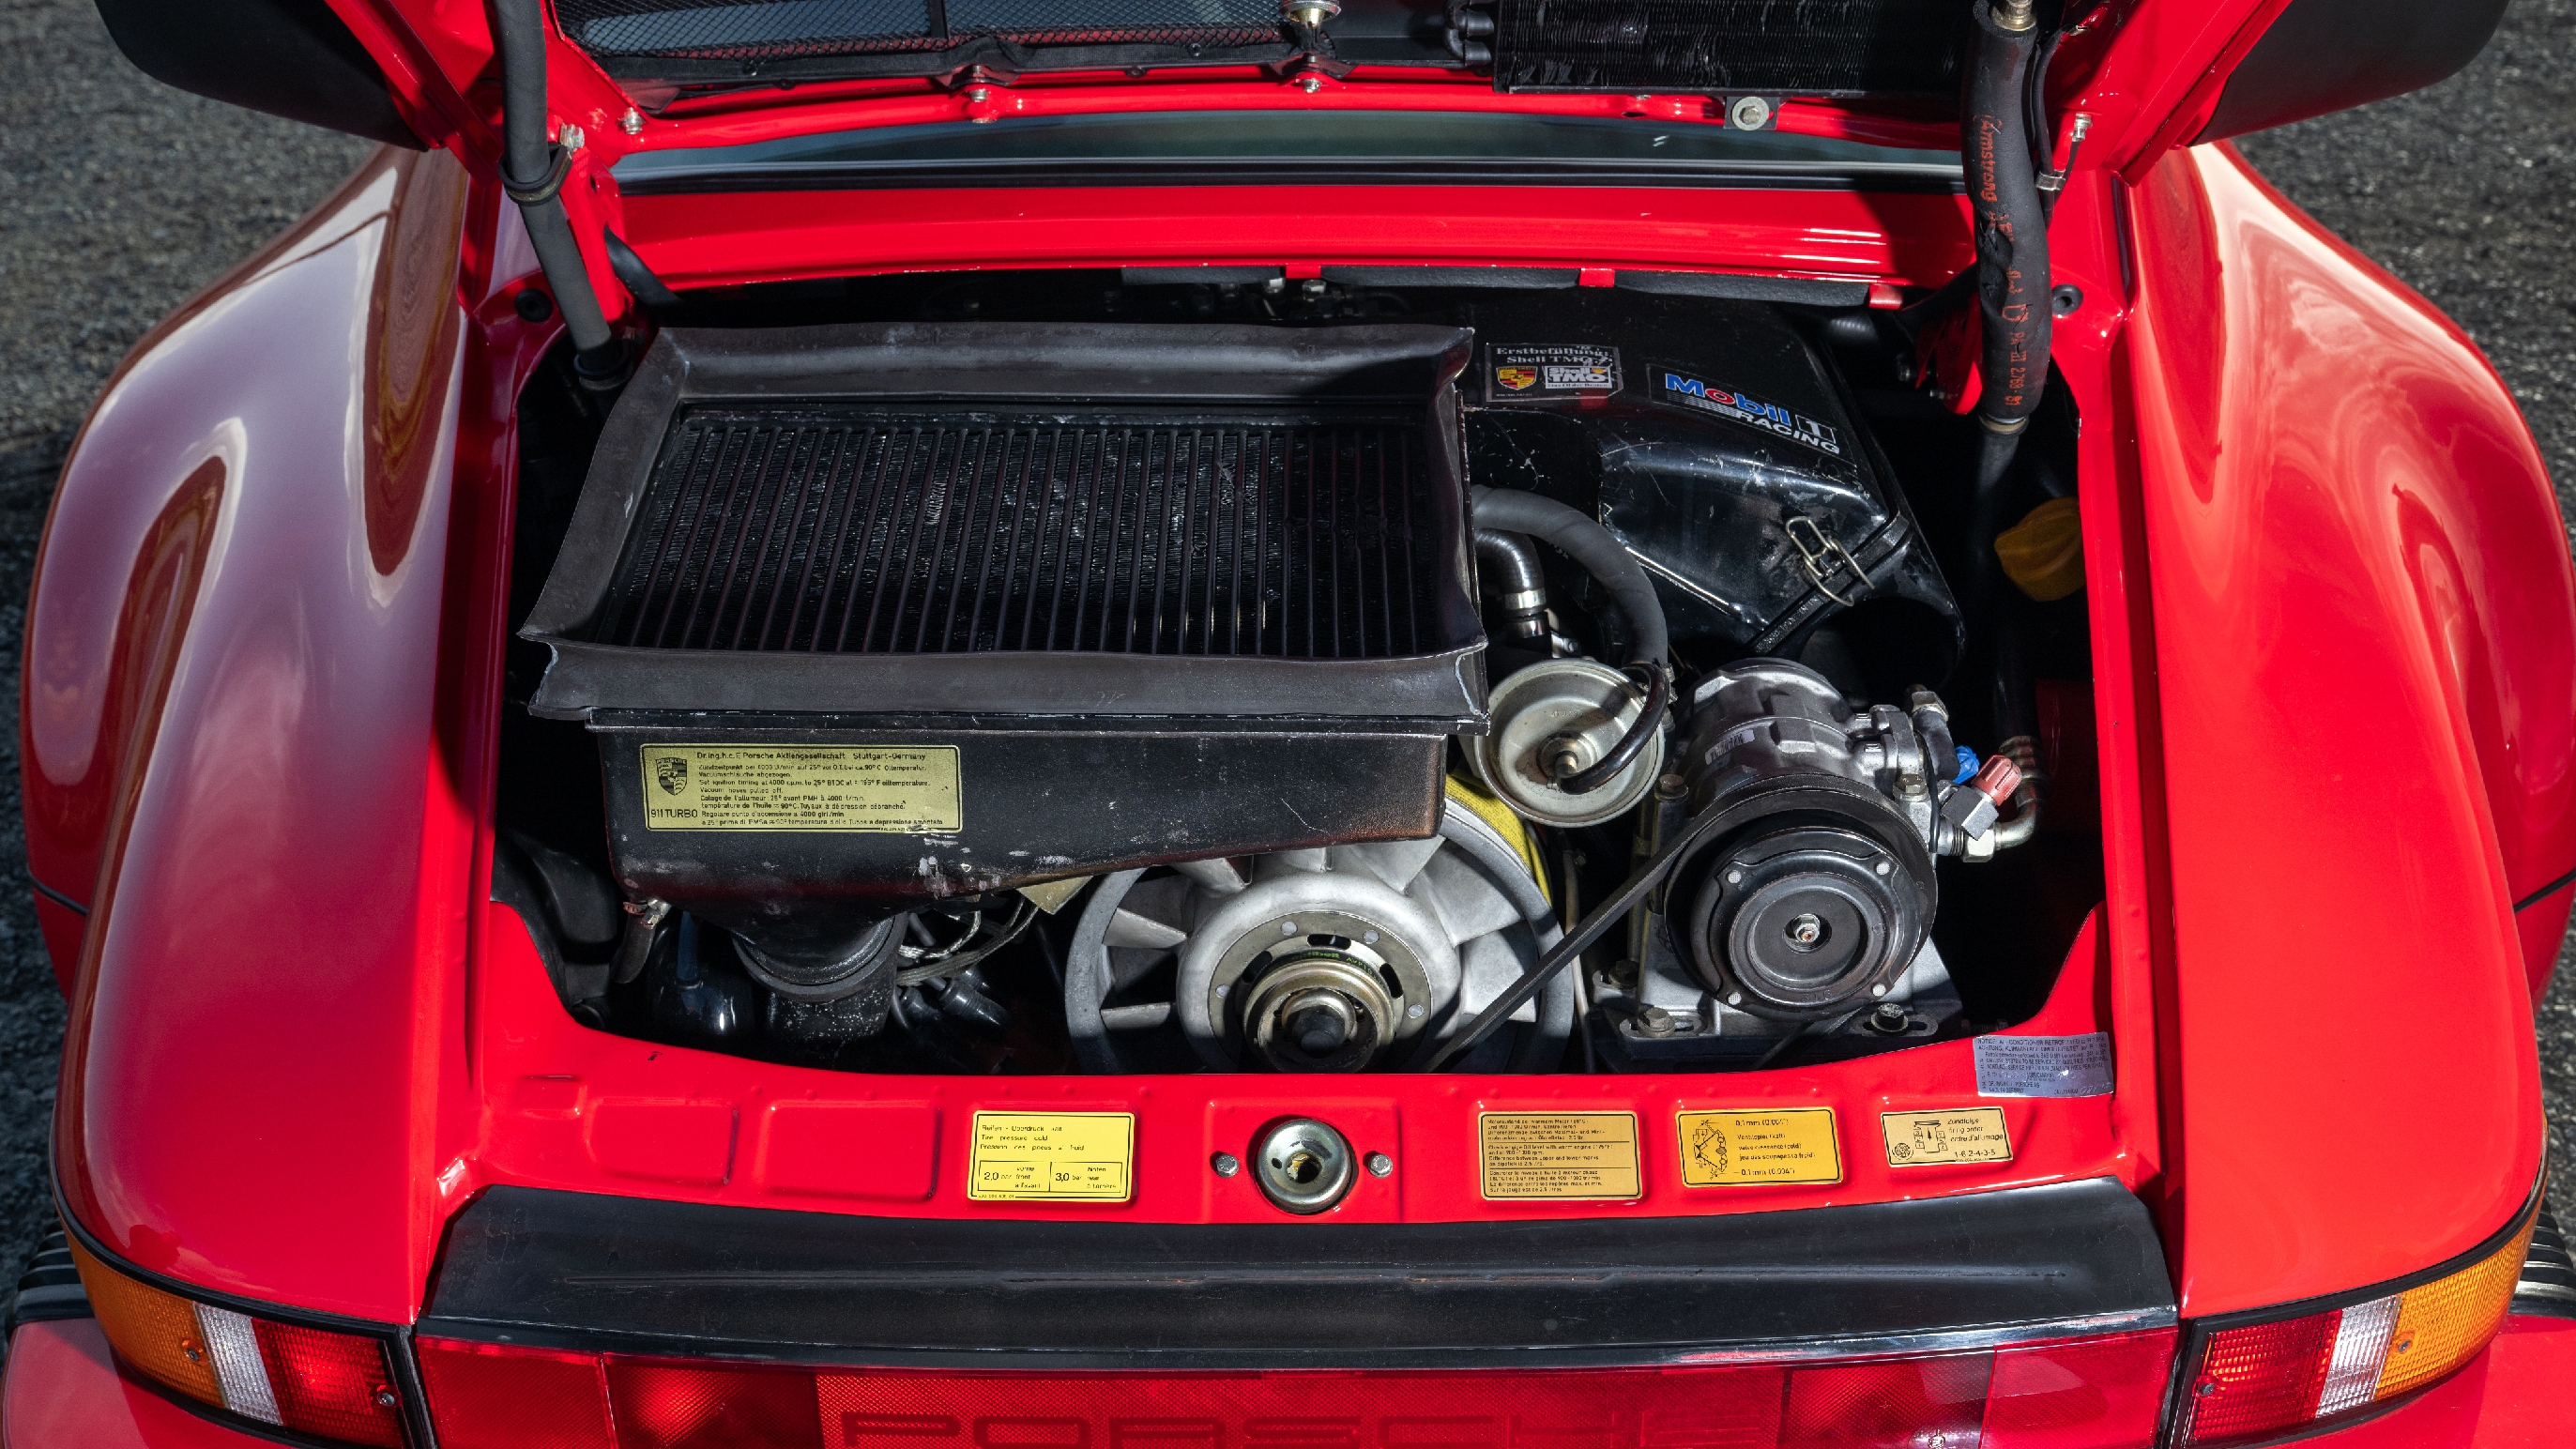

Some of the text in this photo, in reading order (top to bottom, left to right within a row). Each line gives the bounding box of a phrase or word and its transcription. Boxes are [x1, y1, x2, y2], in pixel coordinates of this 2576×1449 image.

[1980, 119, 1998, 203] Armstrong
[1506, 356, 1547, 364] Shell
[1549, 374, 1607, 383] TMO
[1665, 373, 1792, 426] Mobil
[1736, 409, 1840, 455] RACING
[776, 752, 846, 760] Aktiengesellschaft
[852, 753, 926, 761] Stuttgart-Germany
[650, 808, 698, 818] 911 TURBO
[1055, 1172, 1070, 1182] 3,0
